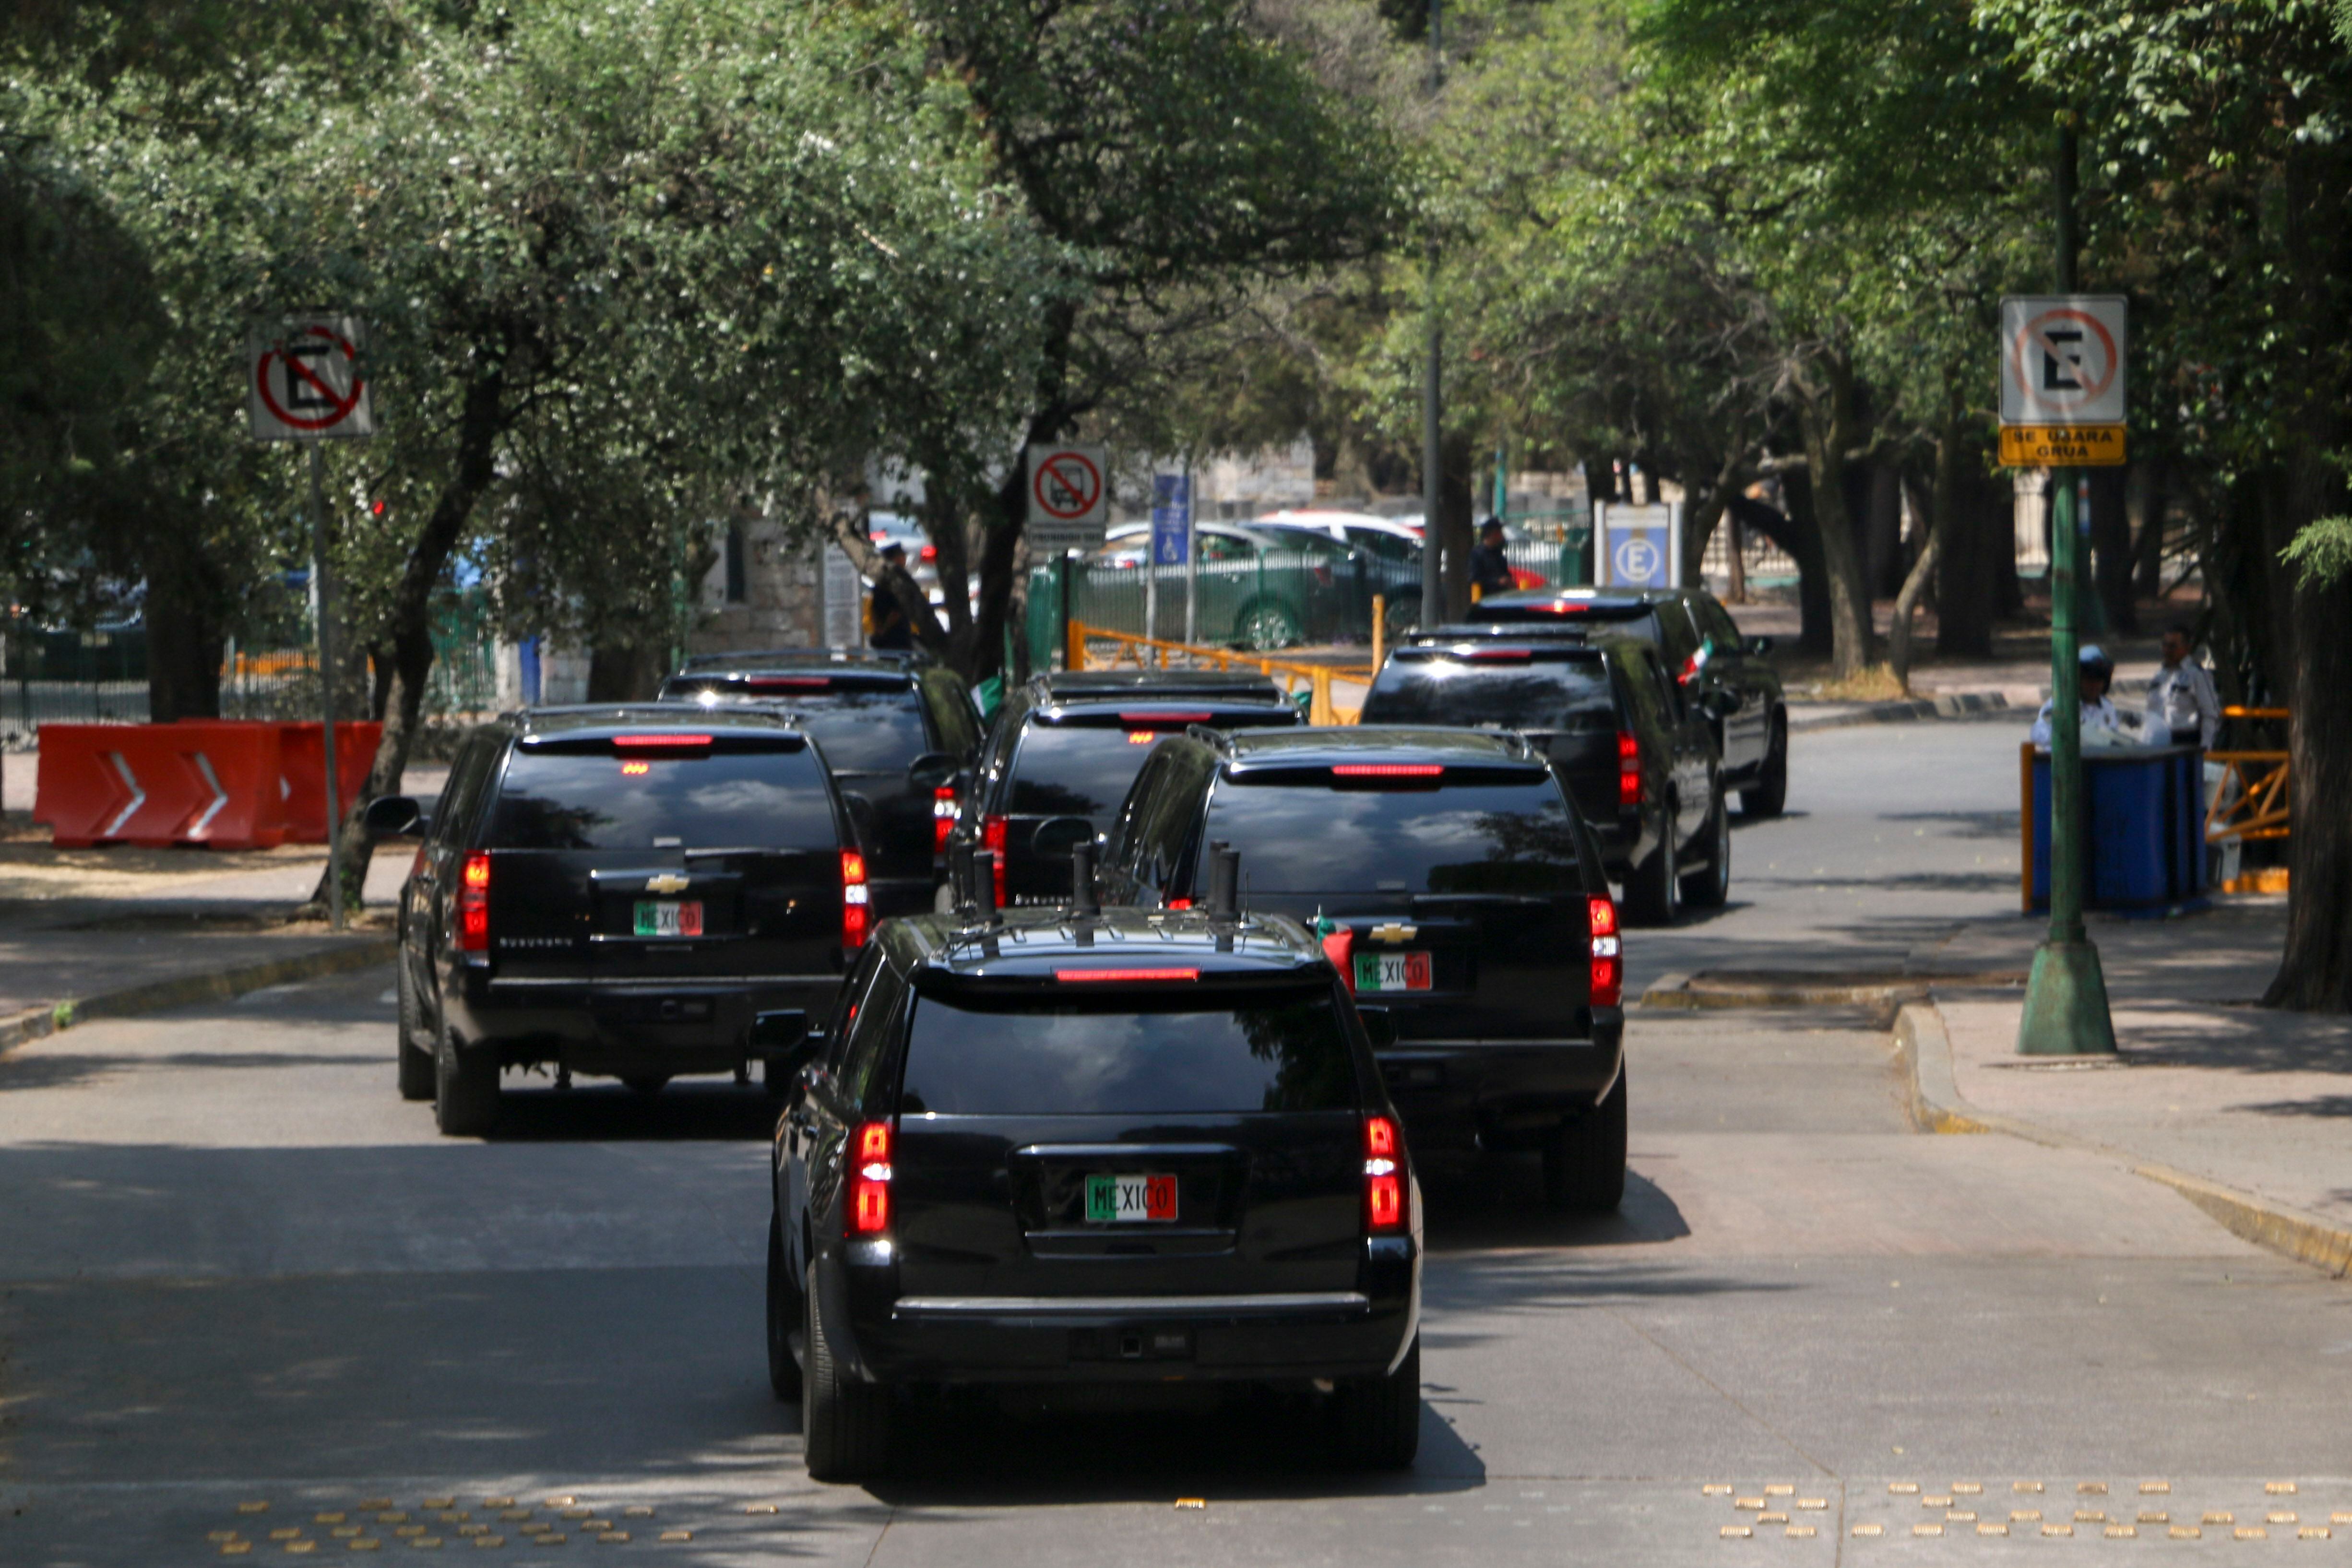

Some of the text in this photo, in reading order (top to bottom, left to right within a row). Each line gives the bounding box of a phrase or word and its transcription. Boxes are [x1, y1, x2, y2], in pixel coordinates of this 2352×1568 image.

[2014, 431, 2035, 442] SE
[2037, 446, 2089, 457] GRUA
[1627, 545, 1646, 574] E
[641, 909, 695, 929] MEXICO
[1362, 961, 1423, 983] MEXICO
[1094, 1184, 1168, 1212] MEXICO
